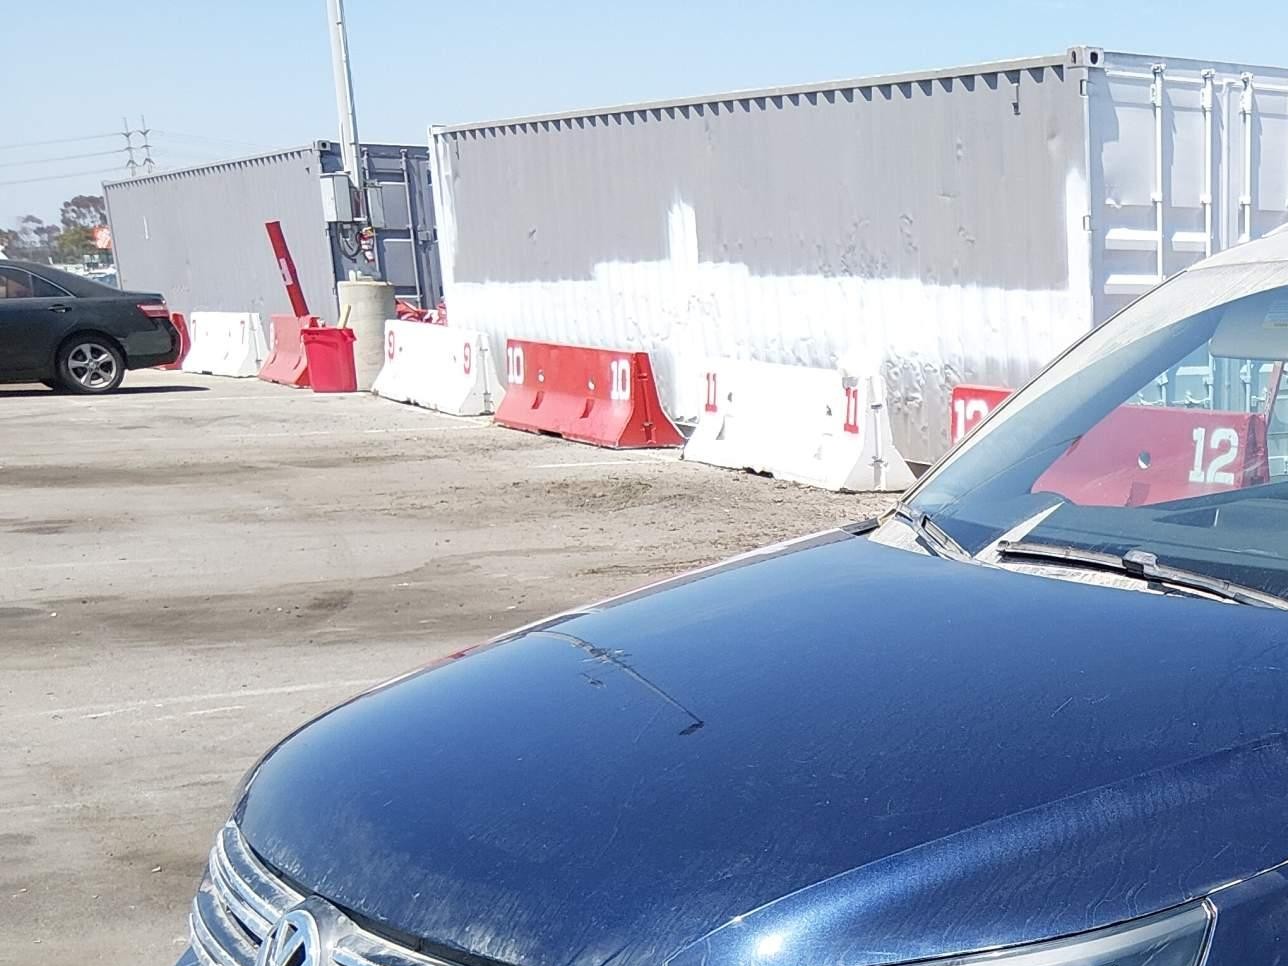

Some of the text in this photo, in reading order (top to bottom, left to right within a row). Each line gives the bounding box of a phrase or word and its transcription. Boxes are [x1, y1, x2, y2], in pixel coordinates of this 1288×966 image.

[388, 330, 396, 360] 9
[463, 342, 472, 375] 9
[507, 347, 525, 385] 10
[610, 359, 631, 401] 10
[705, 372, 718, 412] 11
[843, 386, 859, 434] 11
[1188, 426, 1239, 485] 12
